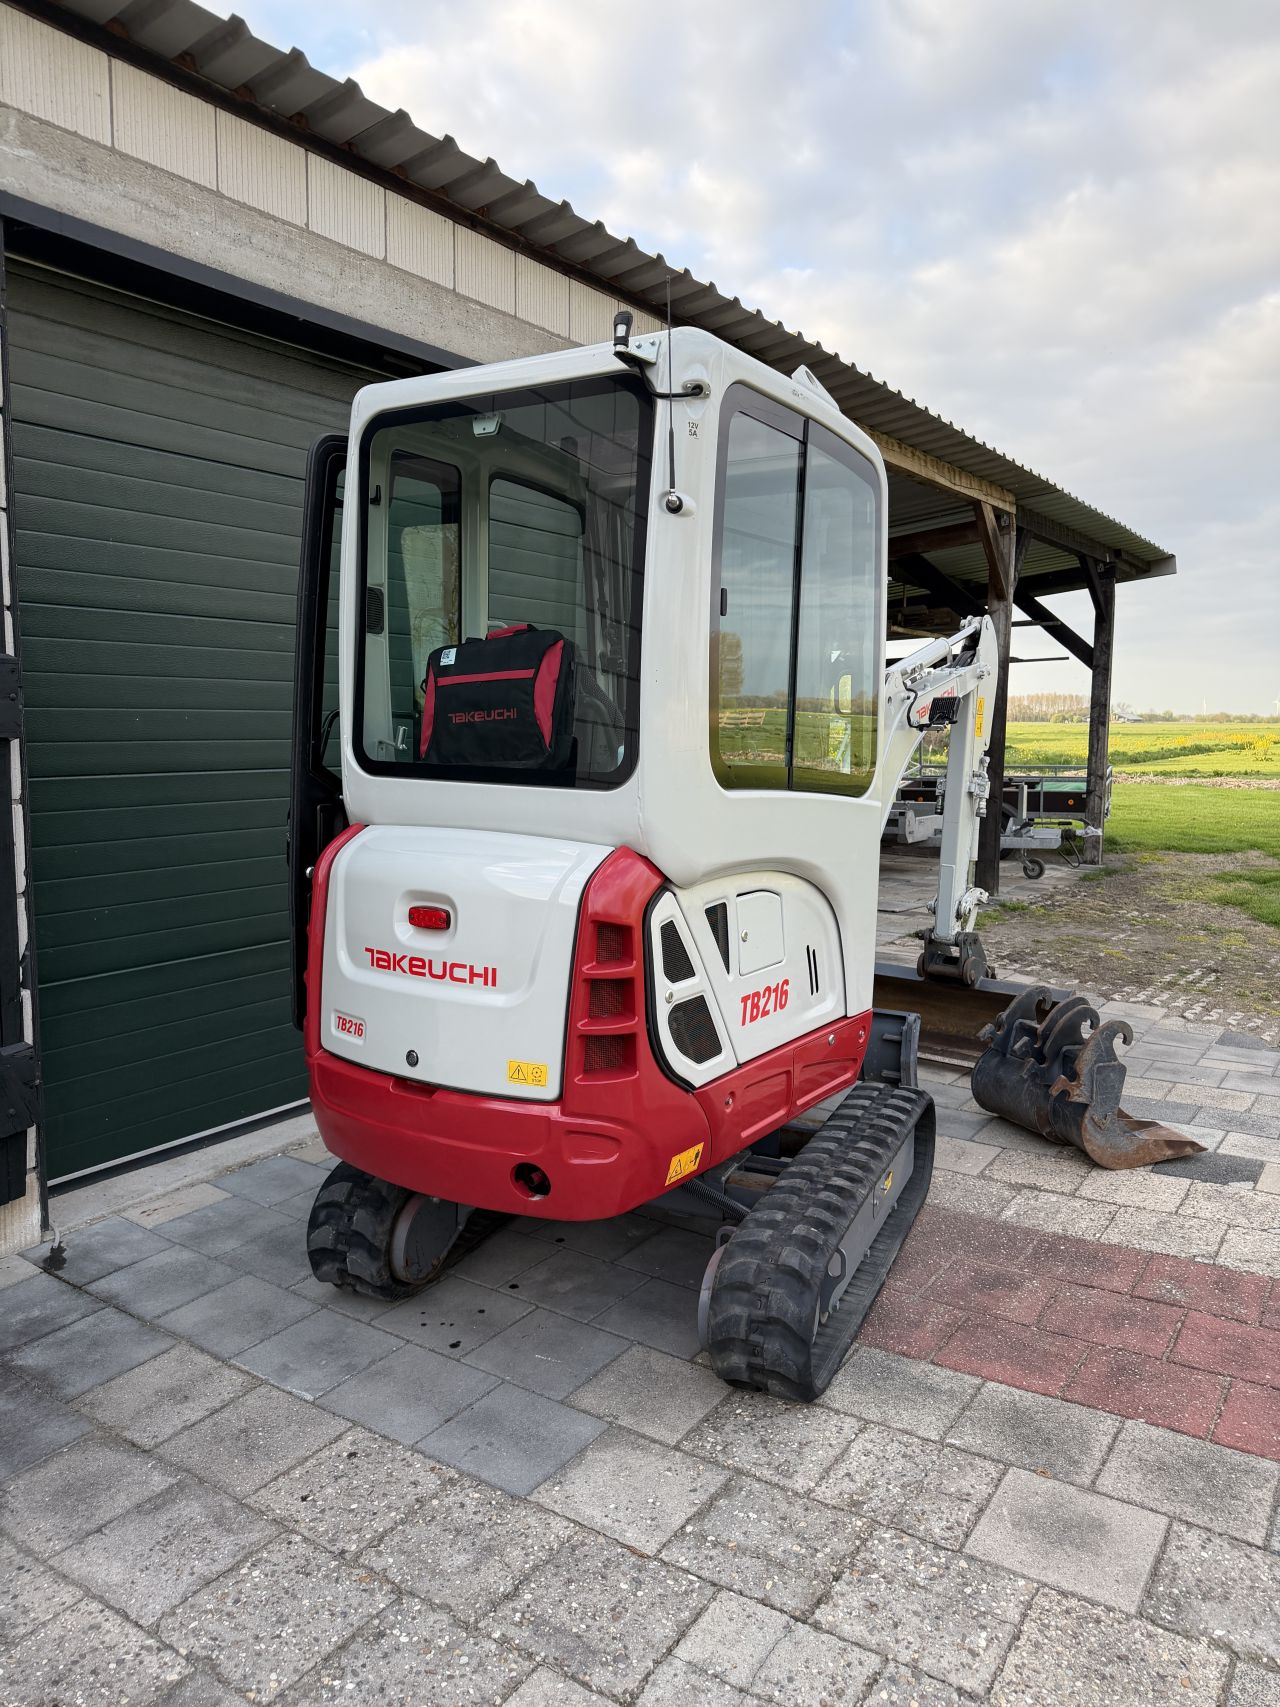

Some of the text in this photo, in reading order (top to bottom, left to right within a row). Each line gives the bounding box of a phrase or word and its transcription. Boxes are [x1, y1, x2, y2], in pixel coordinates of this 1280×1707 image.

[688, 421, 699, 430] 12V
[448, 708, 517, 724] TAKEUCHI
[364, 946, 497, 988] TAKEUCHI
[740, 978, 790, 1027] TB216
[336, 1015, 364, 1038] TB216
